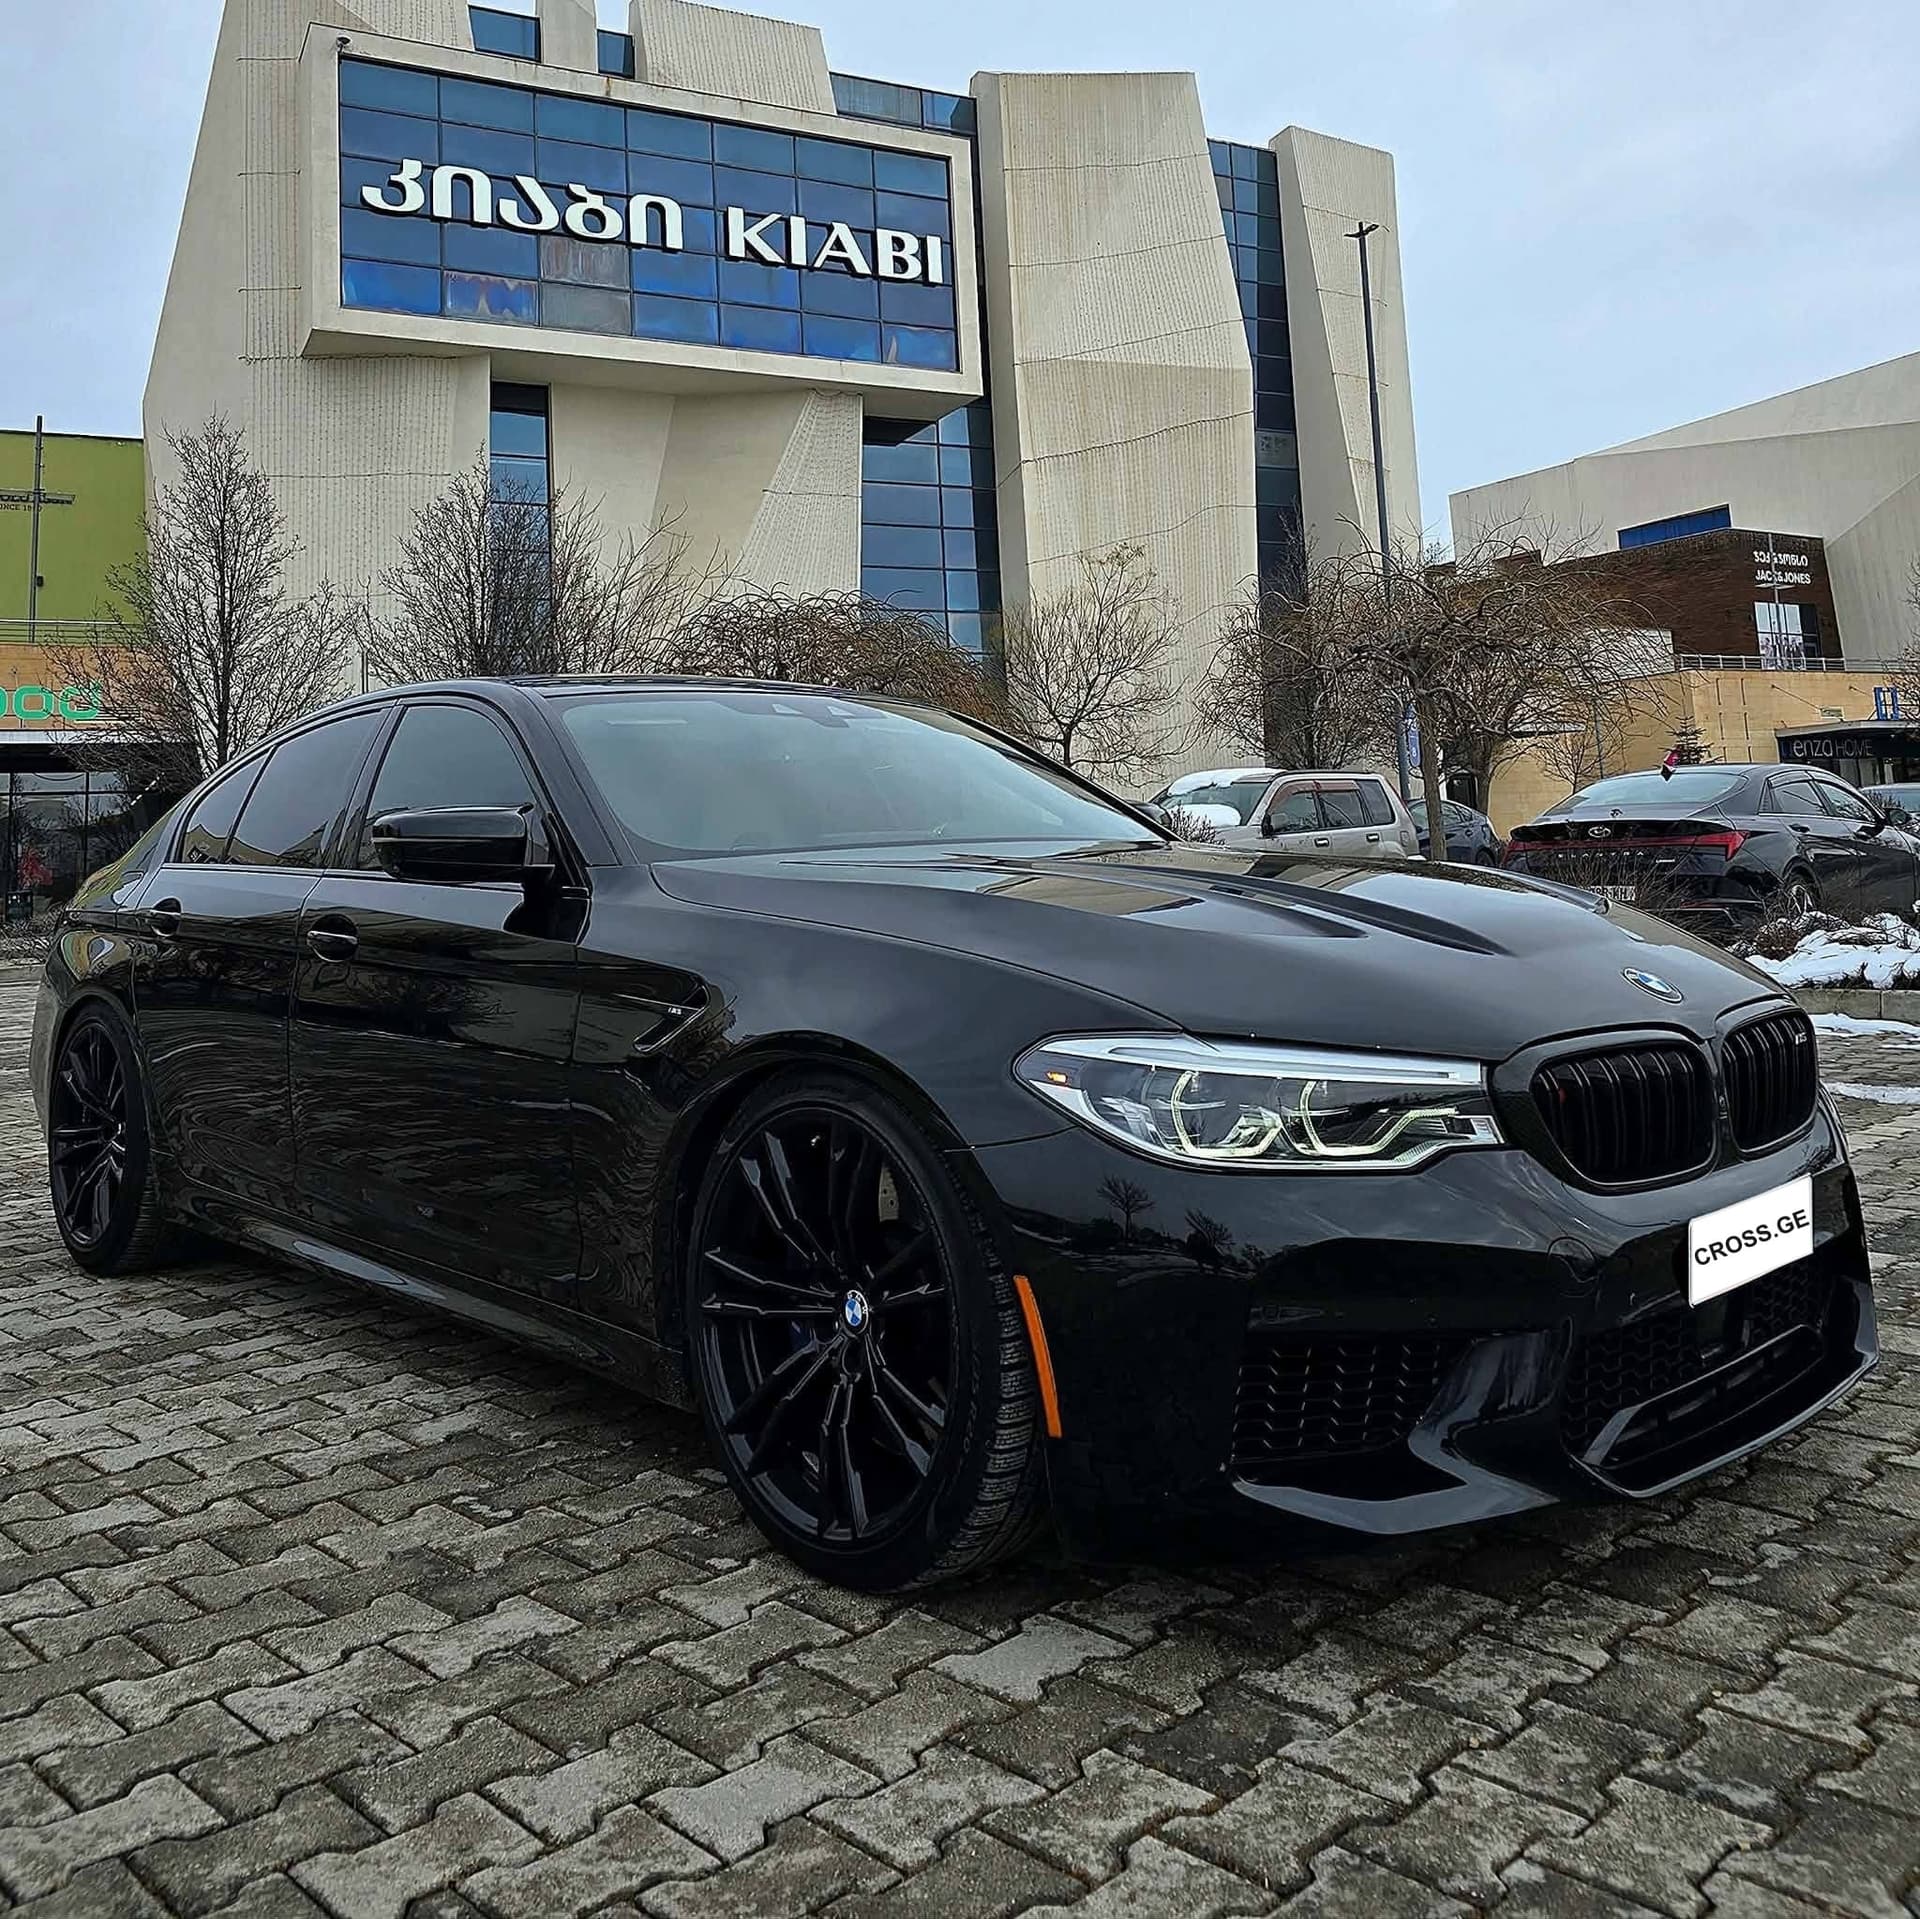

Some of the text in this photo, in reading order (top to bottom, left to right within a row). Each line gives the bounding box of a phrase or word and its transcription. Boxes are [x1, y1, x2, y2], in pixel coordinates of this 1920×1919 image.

[361, 157, 945, 284] კიაბი KIABI
[1793, 739, 1833, 757] enza
